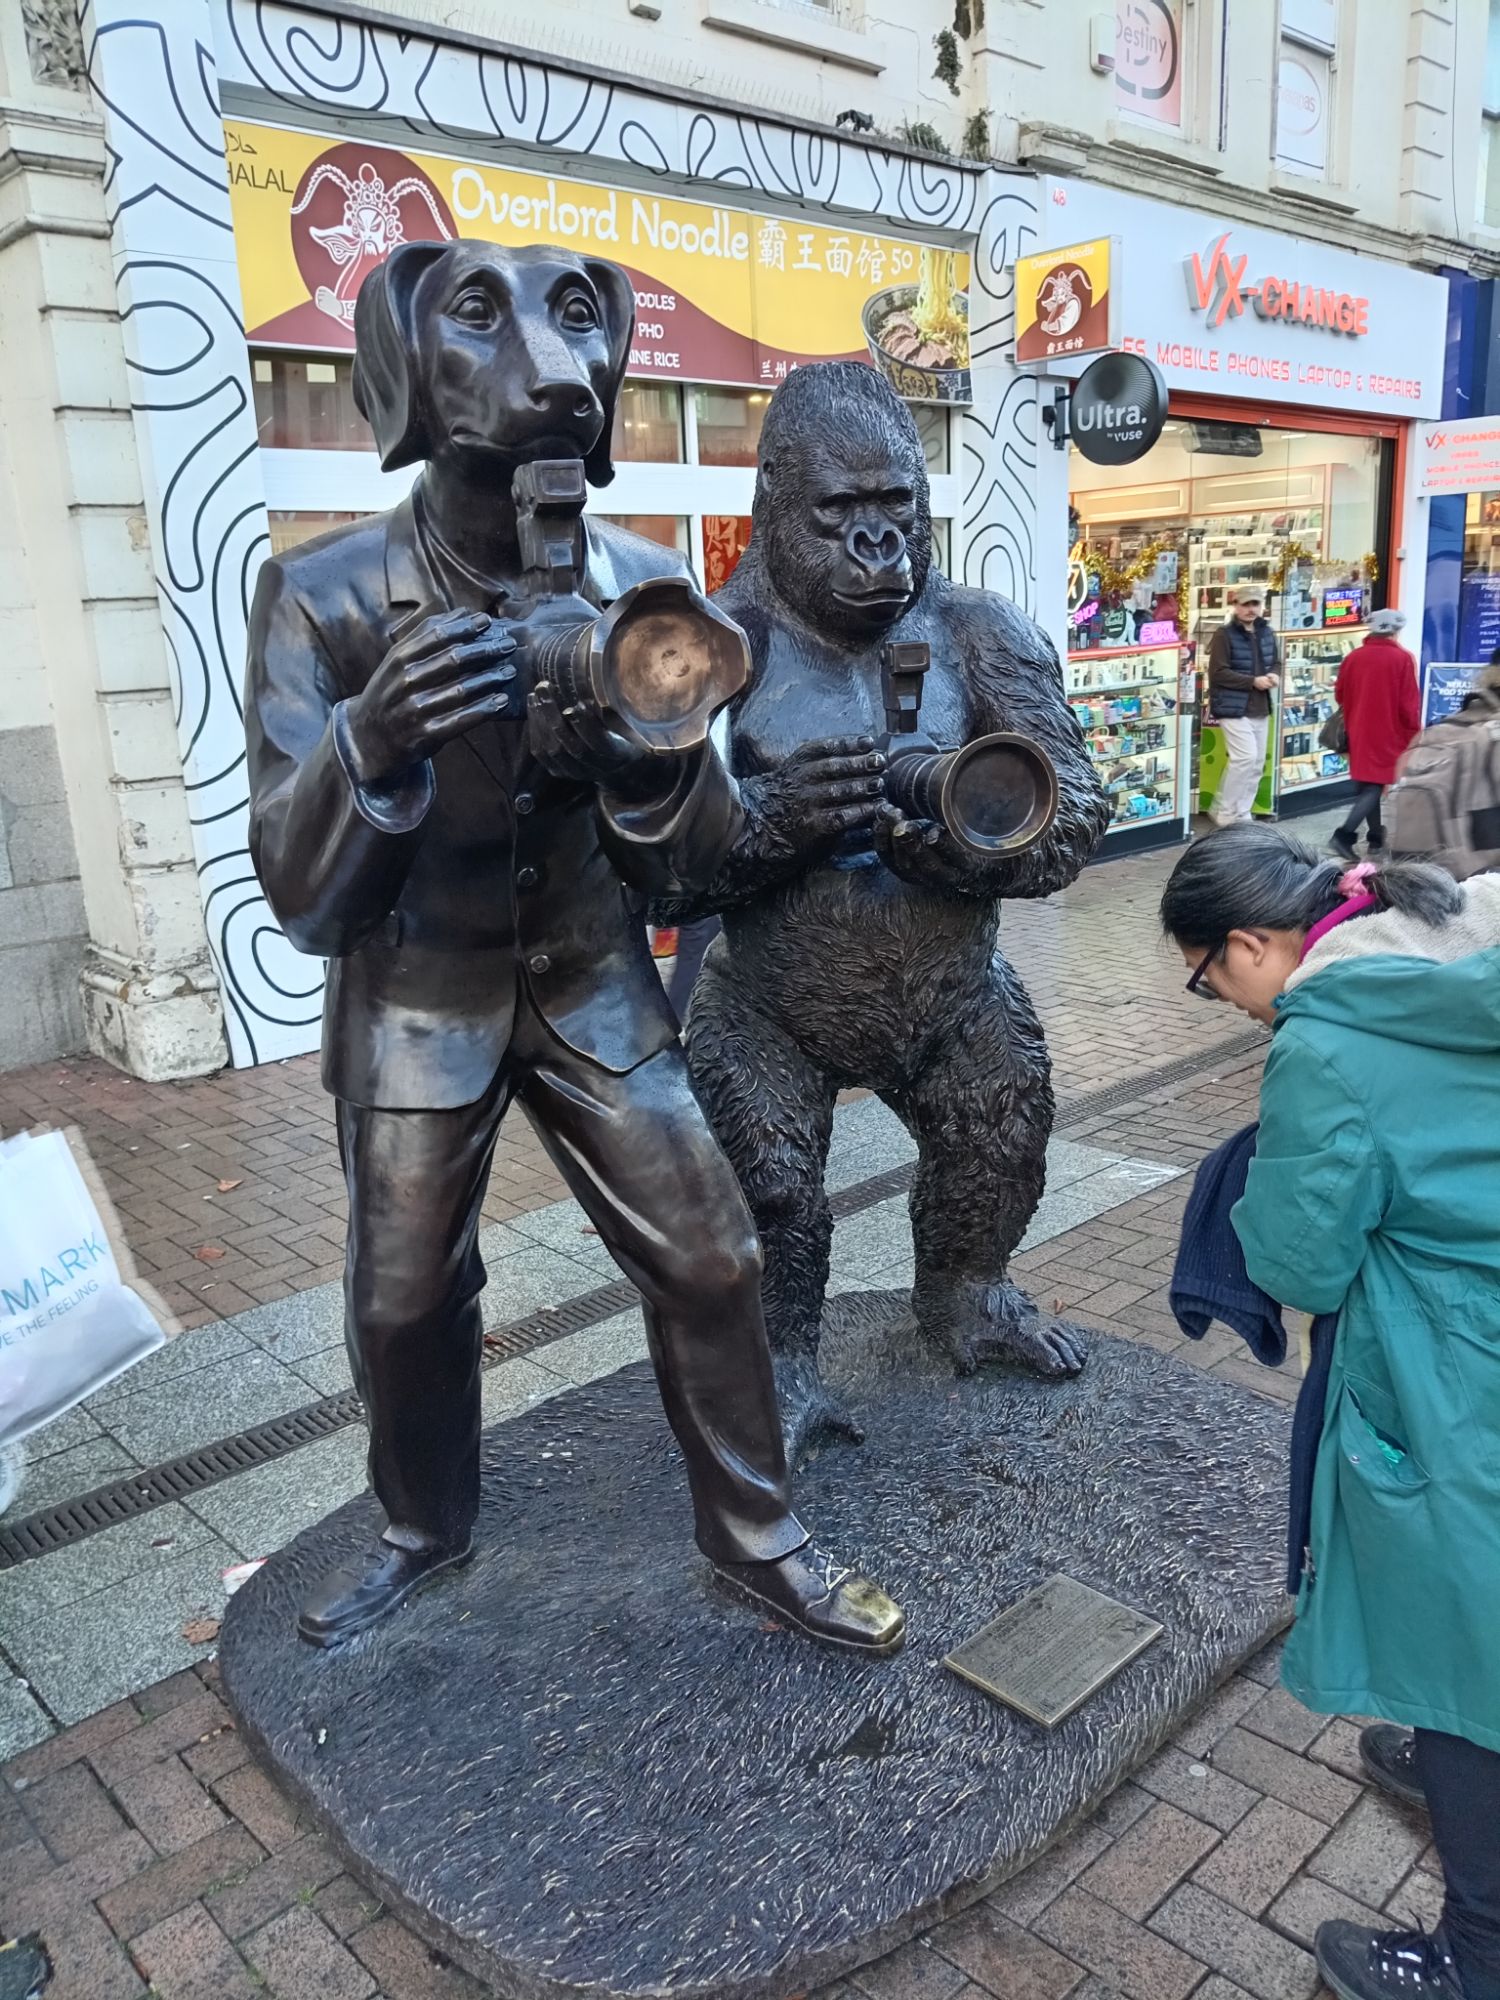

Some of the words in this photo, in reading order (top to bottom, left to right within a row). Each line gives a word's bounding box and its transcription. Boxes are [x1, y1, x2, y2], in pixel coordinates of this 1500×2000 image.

[451, 167, 619, 242] Overlord
[631, 198, 749, 260] Noodle
[758, 220, 887, 284] 霸王面馆
[638, 321, 664, 339] PHO
[653, 351, 680, 368] RICE
[1157, 341, 1219, 372] MOBILE
[1227, 352, 1290, 382] PHONES
[1298, 362, 1351, 389] LAPTOP
[1369, 374, 1422, 400] REPAIRS
[1077, 403, 1147, 431] Ultra.
[1074, 602, 1098, 625] SHOP
[16, 1314, 46, 1338] THE
[47, 1279, 99, 1321] FEELING
